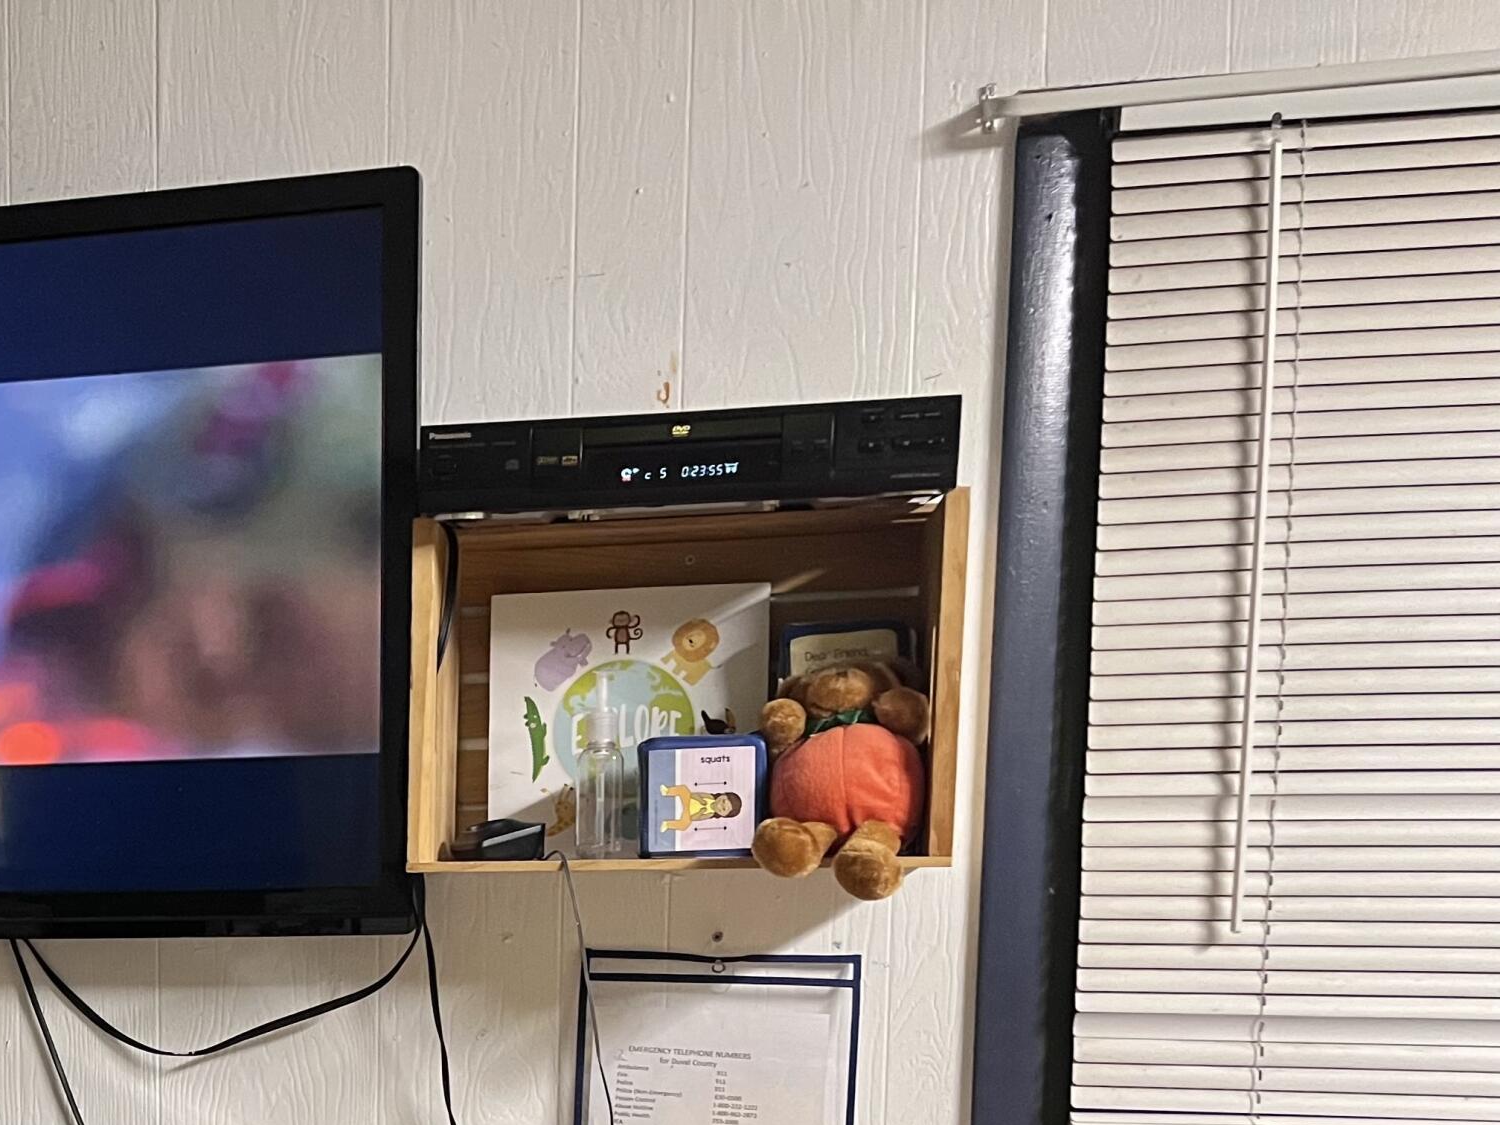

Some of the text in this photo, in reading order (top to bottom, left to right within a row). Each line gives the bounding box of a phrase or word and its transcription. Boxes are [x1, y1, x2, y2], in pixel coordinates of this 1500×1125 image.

[571, 704, 682, 757] ELORE
[700, 754, 731, 765] squats
[628, 1045, 751, 1060] EMERGENCY TELEPHONE NUMBERS
